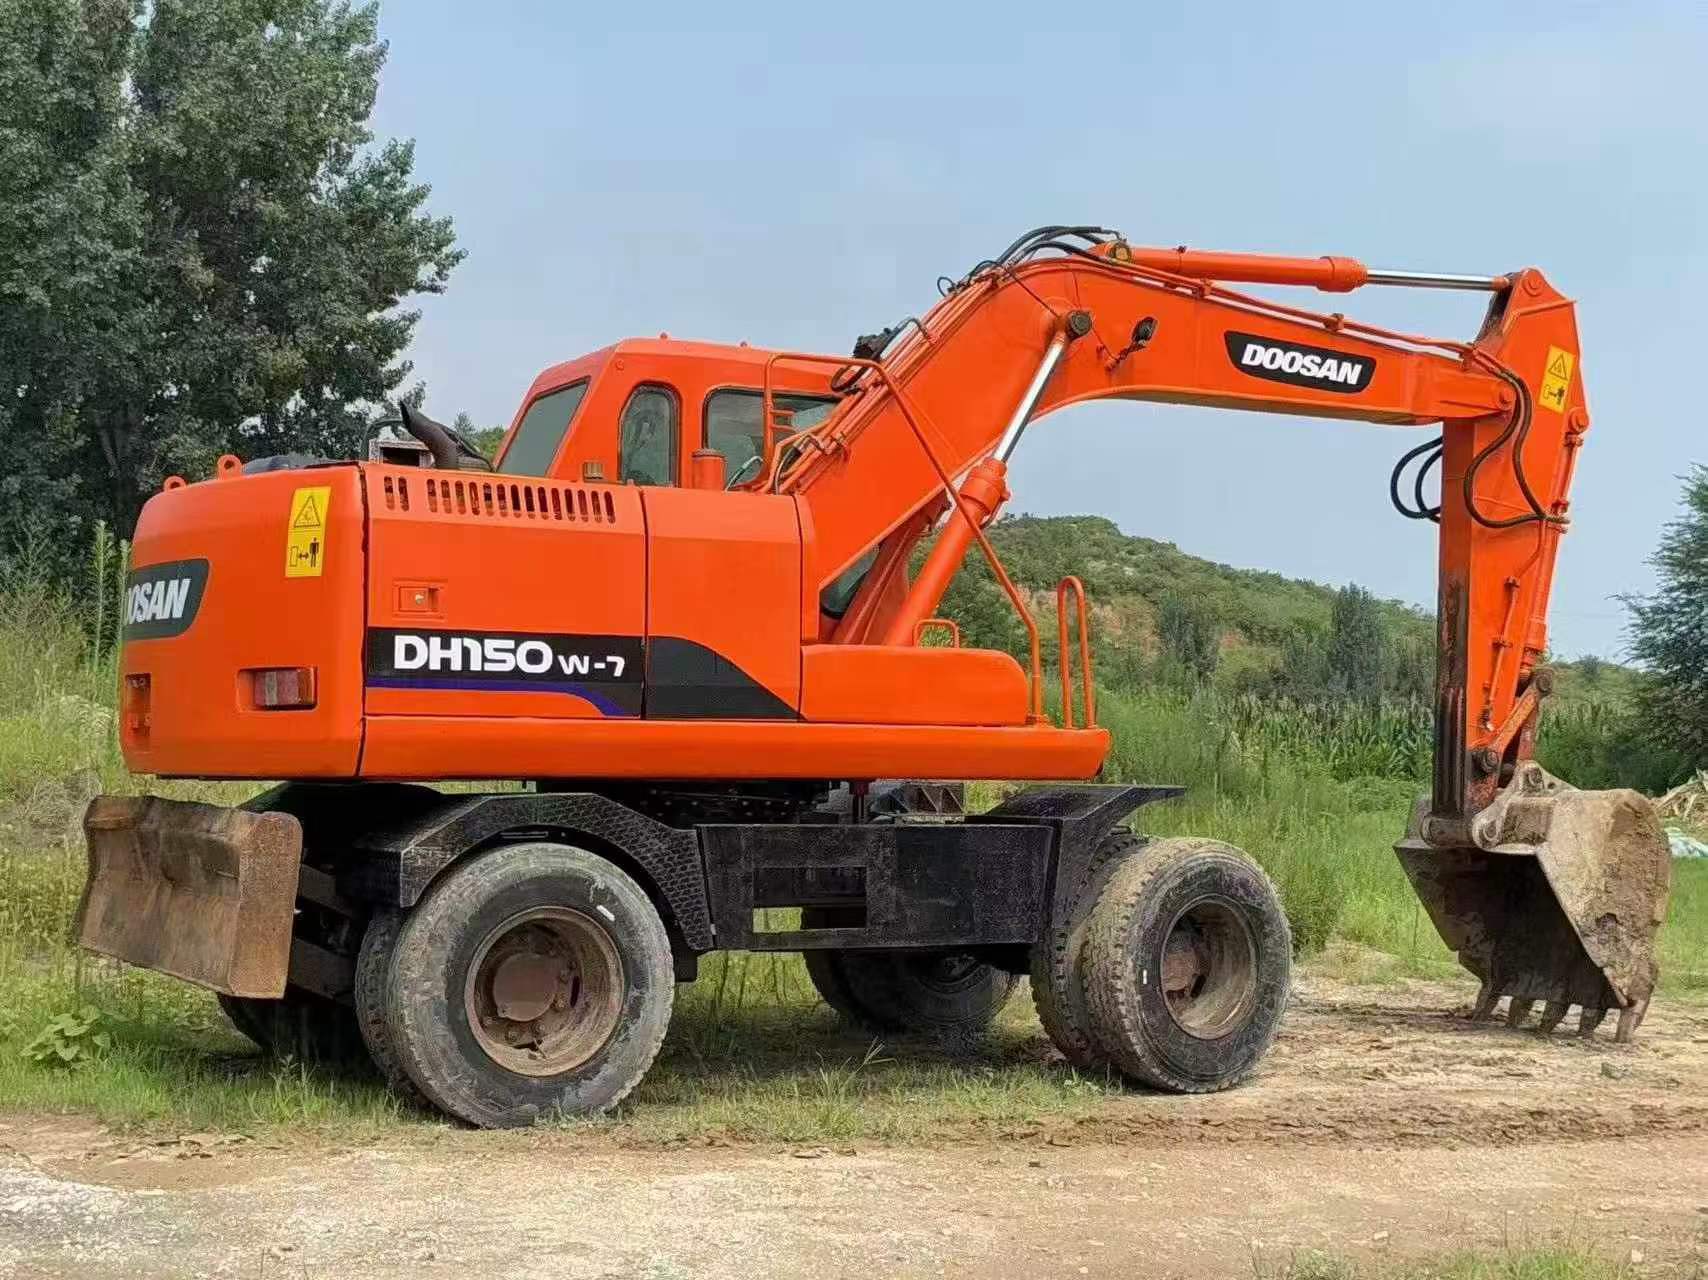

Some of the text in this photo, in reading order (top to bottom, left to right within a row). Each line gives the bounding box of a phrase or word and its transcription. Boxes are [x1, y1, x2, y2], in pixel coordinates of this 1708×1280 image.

[1241, 343, 1362, 385] DOOSAN
[127, 579, 191, 624] OSAN
[394, 635, 553, 674] DH150
